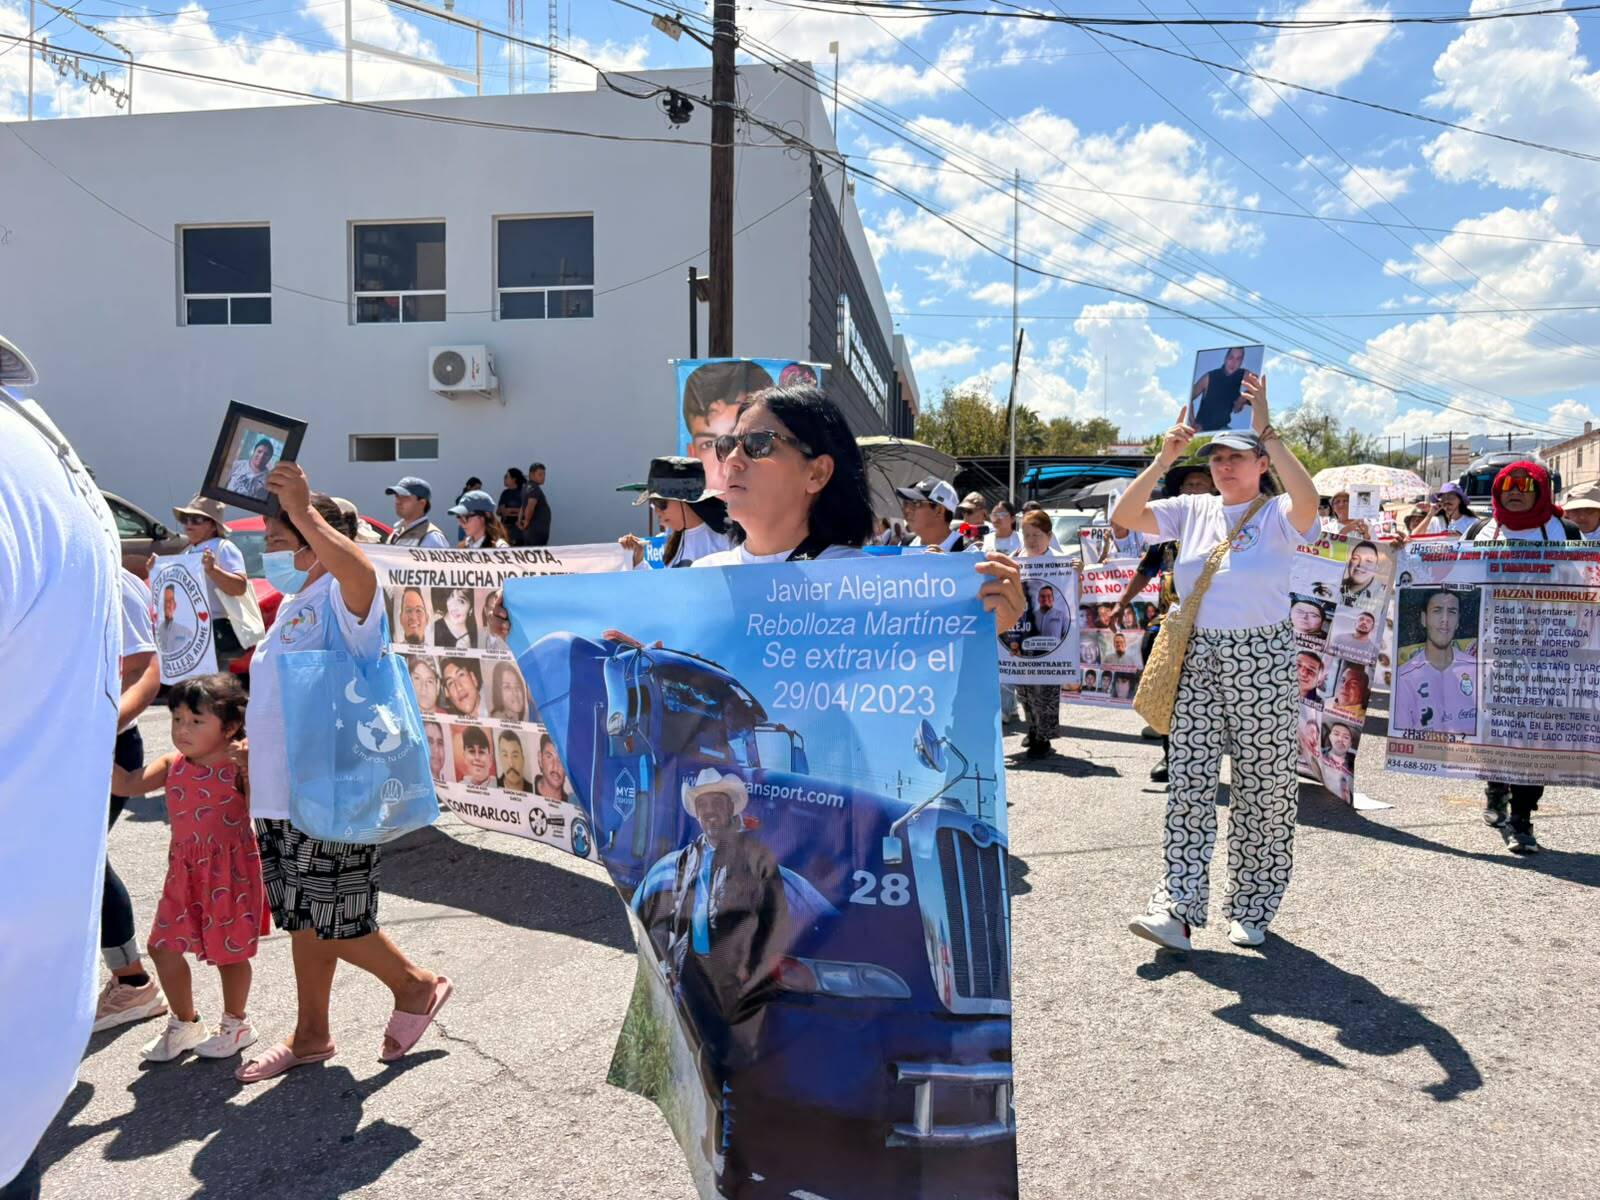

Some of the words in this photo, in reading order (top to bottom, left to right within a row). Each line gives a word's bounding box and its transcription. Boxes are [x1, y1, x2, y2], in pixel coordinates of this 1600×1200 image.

[409, 549, 427, 562] SU
[429, 549, 493, 564] AUSENCIA
[494, 550, 513, 564] SE
[514, 549, 563, 566] NOTA,
[389, 569, 446, 586] NUESTRA
[451, 570, 494, 588] LUCHA
[766, 579, 832, 603] Javier
[838, 571, 957, 607] Alejandro
[1493, 589, 1535, 600] HAZZAN
[1536, 589, 1597, 602] RODRIGUEZ
[1494, 606, 1515, 617] Edad
[746, 612, 856, 637] Rebolloza
[864, 609, 978, 637] Martínez
[1547, 628, 1589, 640] DELGADA
[1541, 640, 1580, 649] MORENO
[762, 641, 796, 669] Se
[805, 640, 917, 672] extravío
[926, 642, 956, 673] el
[1540, 649, 1568, 658] CLARO
[772, 681, 936, 716] 29/04/2023
[1493, 695, 1546, 706] MONTERREY
[1491, 708, 1515, 718] Señas
[1568, 711, 1591, 721] TIENE
[1491, 718, 1527, 729] MANCHA
[1529, 721, 1541, 730] EN
[1543, 722, 1554, 731] EL
[1555, 722, 1584, 732] PECHO
[1491, 728, 1524, 739] BLANCA
[1527, 731, 1539, 741] DE
[1541, 732, 1563, 742] LADO
[616, 787, 635, 798] MYE
[848, 869, 911, 907] 28
